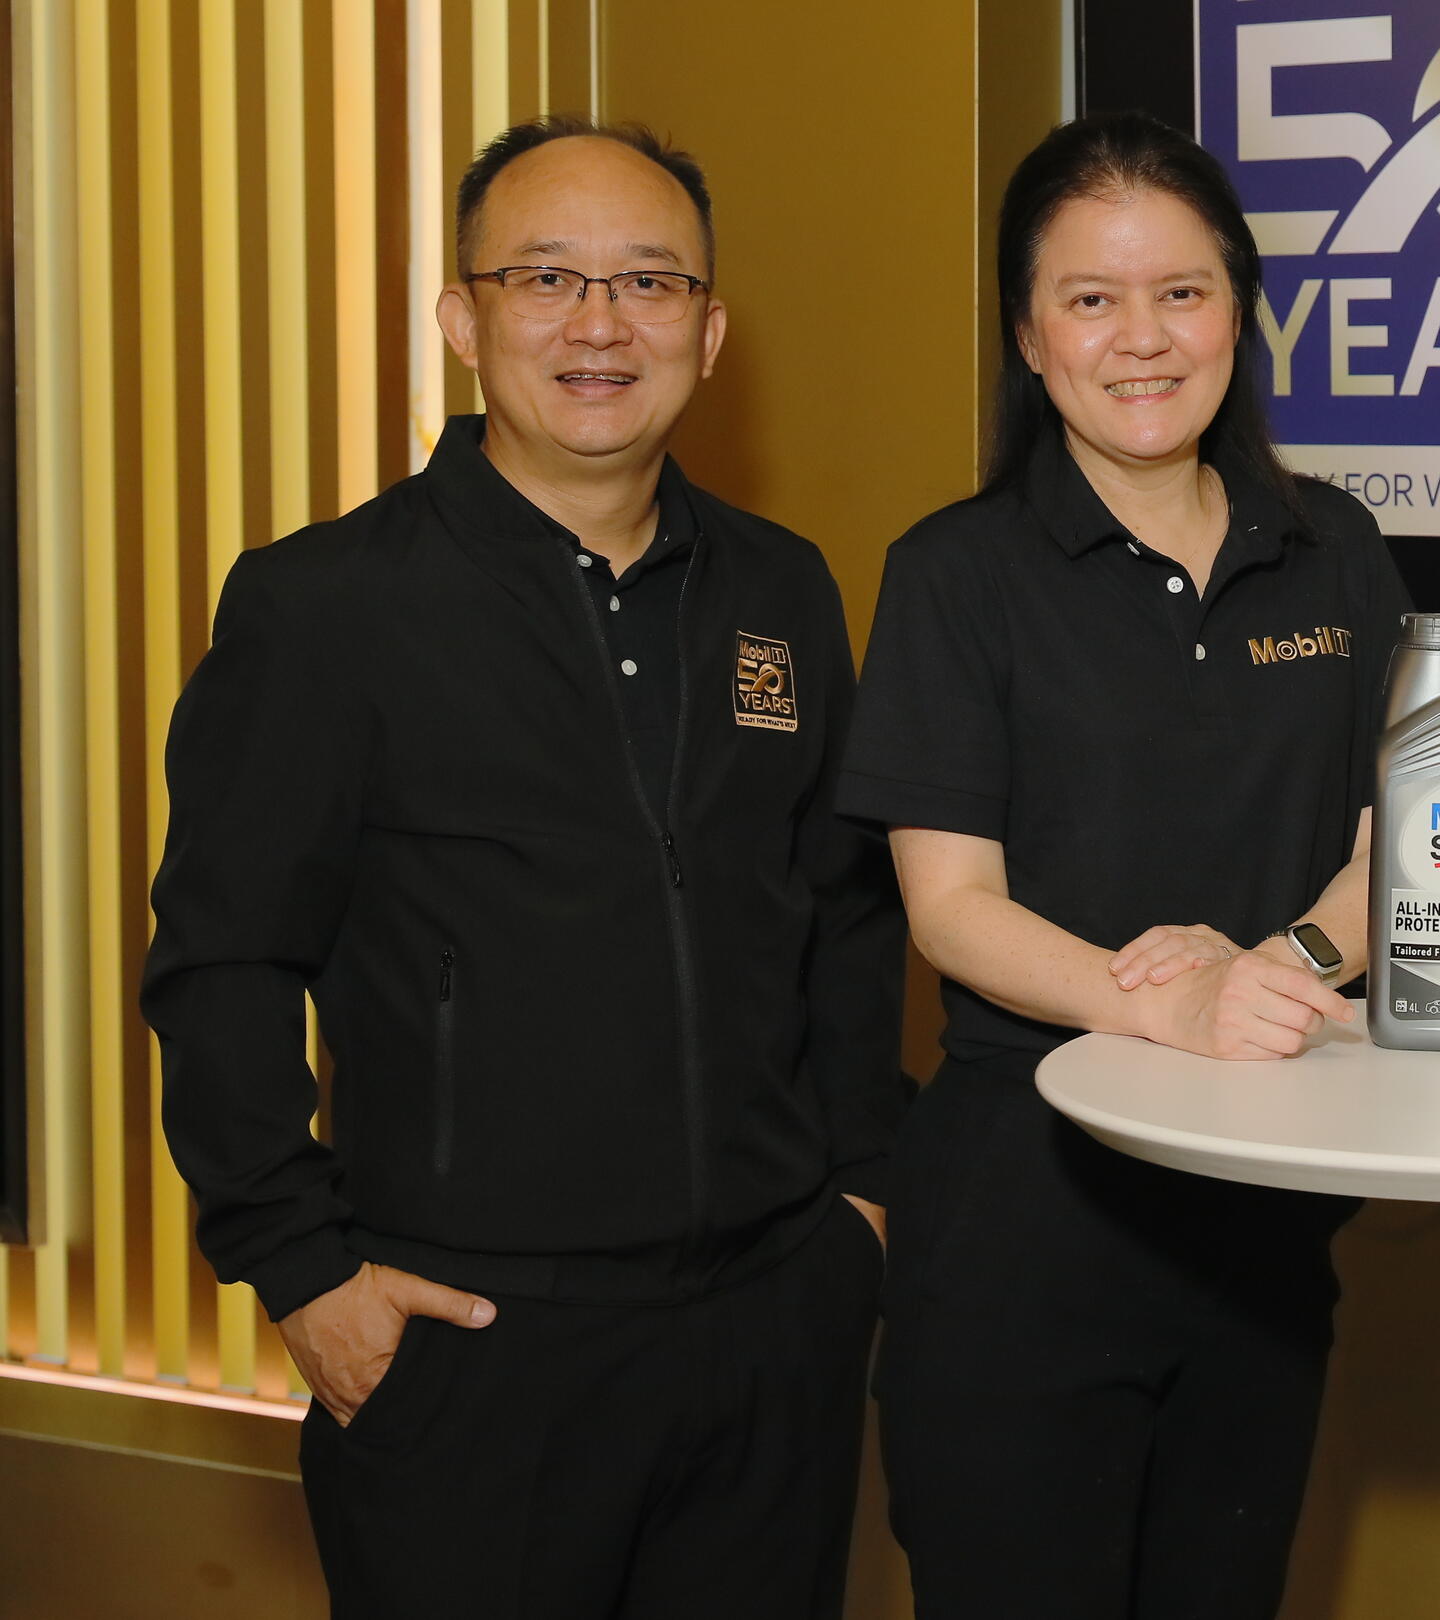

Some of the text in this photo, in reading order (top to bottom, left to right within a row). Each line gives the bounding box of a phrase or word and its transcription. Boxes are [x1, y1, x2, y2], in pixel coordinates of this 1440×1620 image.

[1345, 473, 1414, 507] FOR
[739, 640, 770, 662] Mobil
[1247, 626, 1334, 665] Mobil
[738, 658, 786, 694] 50
[1395, 945, 1432, 957] Tailored
[1409, 1003, 1420, 1013] 4L
